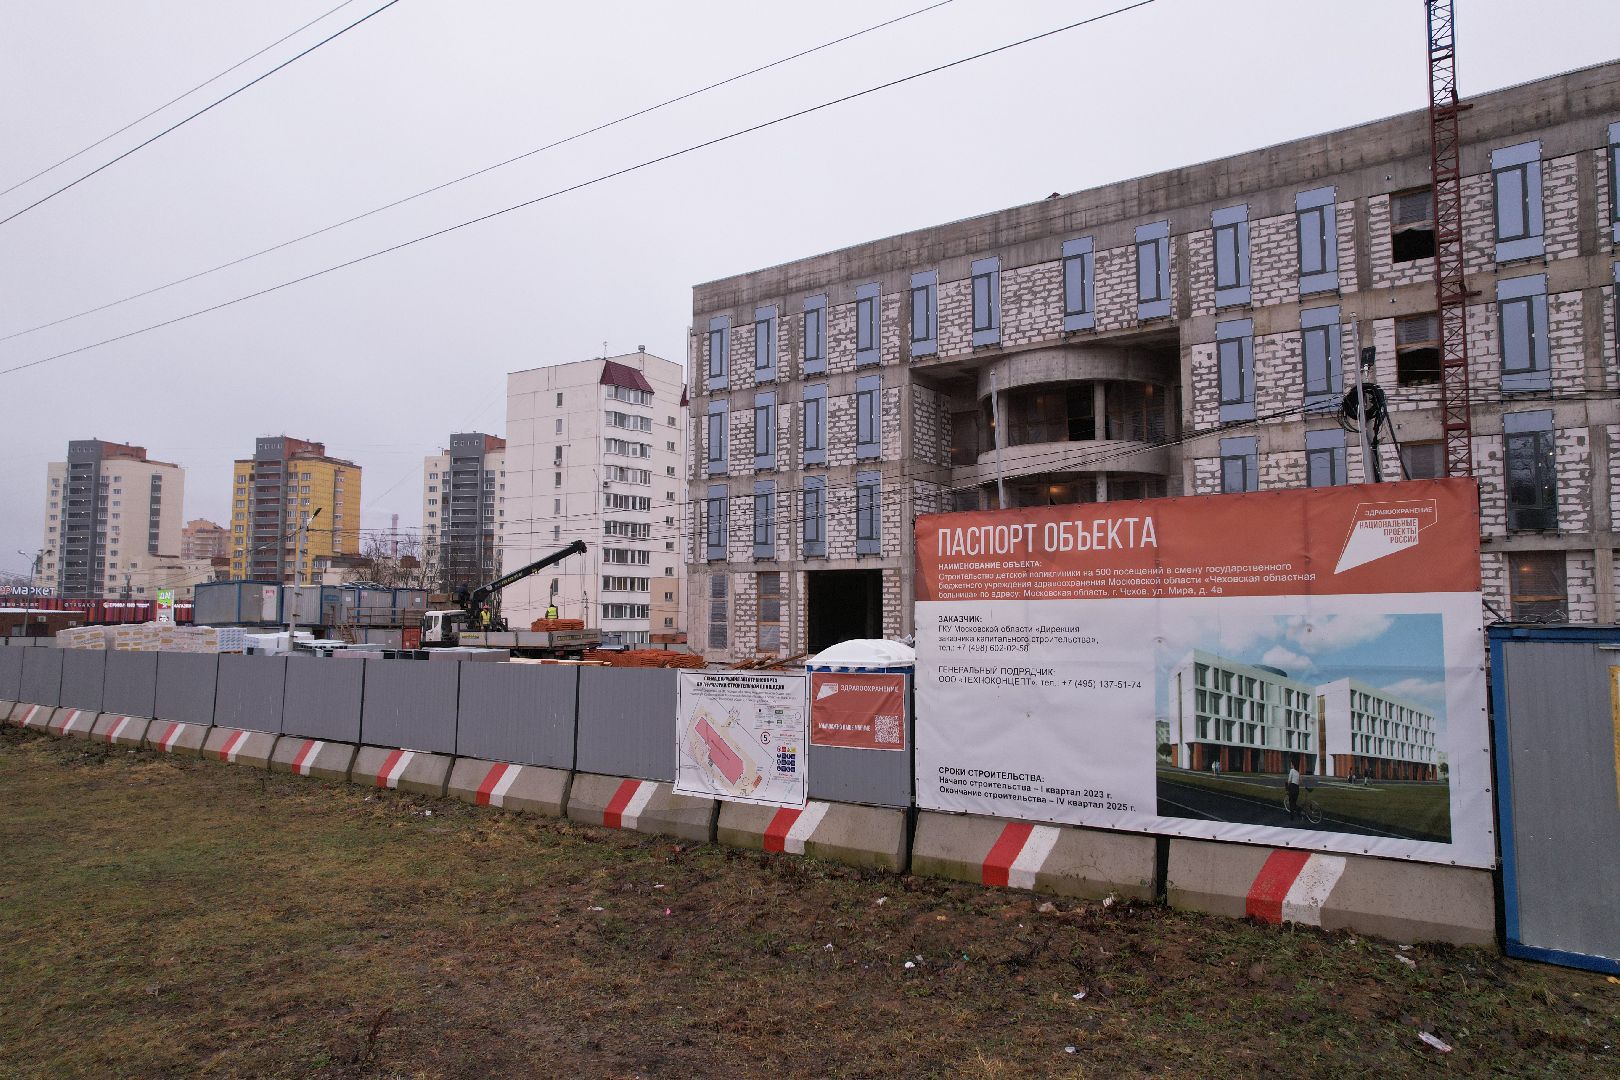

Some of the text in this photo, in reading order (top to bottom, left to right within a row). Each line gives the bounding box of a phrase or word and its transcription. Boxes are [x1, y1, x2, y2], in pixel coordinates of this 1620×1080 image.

[1364, 507, 1433, 516] ЗДРАВООХРАНЕНИЕ
[1359, 519, 1416, 529] НАЦИОНАЛЬНЫЕ
[938, 517, 1158, 556] ПАСПОРТ ОБЪЕКТА
[1383, 527, 1417, 536] ПРОЕКТЫ
[938, 561, 1042, 570] НАИМЕНОВАНИЕ ОБЪЕКТА:
[938, 573, 994, 581] Строительство
[996, 571, 1027, 580] детской
[1029, 570, 1081, 579] поликлиники
[1095, 568, 1111, 576] 500
[1113, 567, 1163, 577] посещений
[1174, 566, 1203, 575] смену
[1205, 563, 1292, 575] государственного
[938, 573, 1316, 590] бюджетного учреждения здравоохранения Московской области «Чеховская областная
[938, 591, 977, 599] больница»
[1023, 588, 1072, 598] Московская
[1152, 588, 1166, 596] ул.
[1168, 586, 1196, 596] Мира,
[1198, 587, 1208, 595] д.
[1210, 586, 1223, 594] 4а
[938, 615, 982, 623] ЗАКАЗЧИК:
[938, 625, 1080, 634] ГКУ Московской области «Дирекция
[1031, 636, 1099, 645] строительства»,
[968, 644, 988, 653] (498)
[989, 644, 1029, 652] 602-02-58
[938, 665, 1055, 677] ГЕНЕРАЛЬНЫЙ ПОДРЯДЧИК:
[938, 675, 957, 683] ООО
[1074, 679, 1096, 689] (495)
[1099, 680, 1142, 689] 137-51-74
[840, 684, 899, 693] ЗДРАВООХРАНЕНИЕ
[938, 766, 1045, 783] СРОКИ СТРОИТЕЛЬСТВА:
[939, 776, 967, 786] Начало
[969, 779, 1031, 792] строительства
[1045, 787, 1081, 797] квартал
[1083, 789, 1104, 799] 2023
[939, 785, 982, 797] Окончание
[984, 791, 1047, 804] строительства
[1056, 797, 1065, 805] IV
[1067, 799, 1104, 809] квартал
[1106, 801, 1128, 811] 2025
